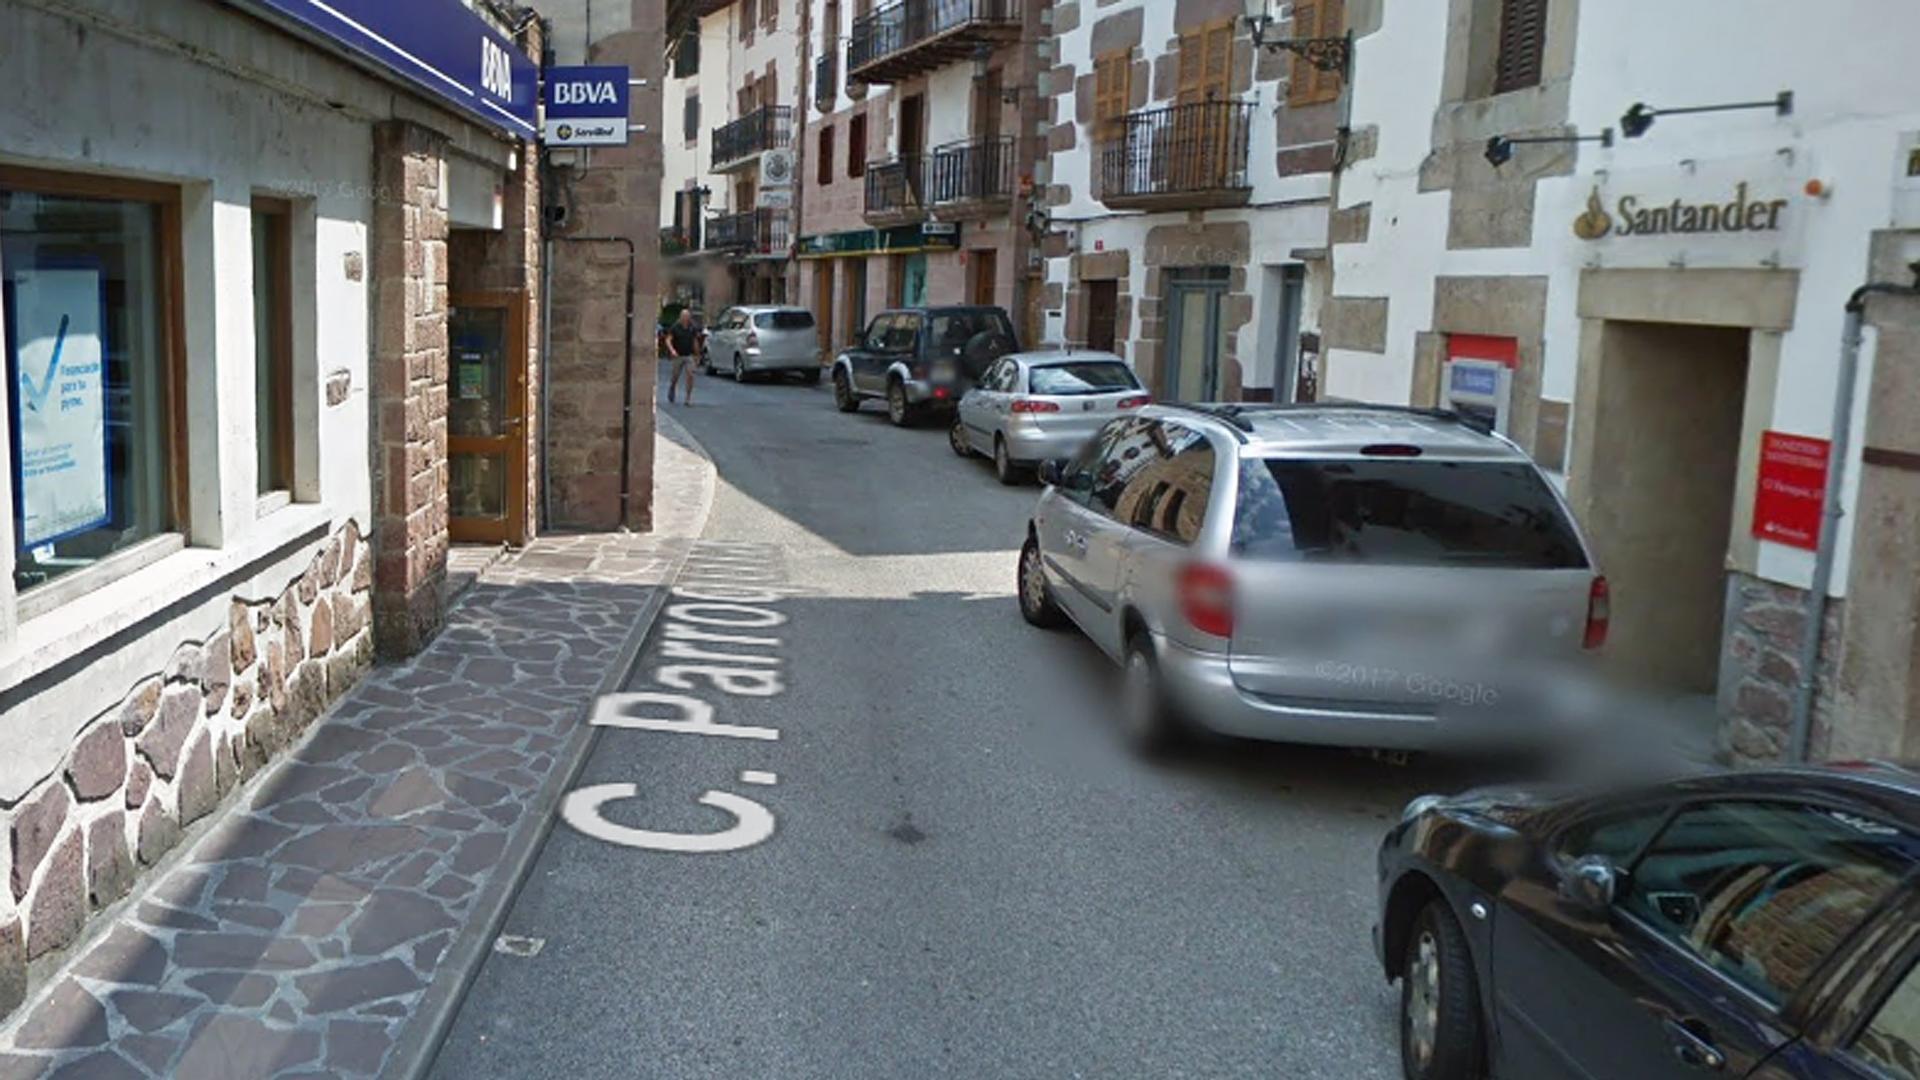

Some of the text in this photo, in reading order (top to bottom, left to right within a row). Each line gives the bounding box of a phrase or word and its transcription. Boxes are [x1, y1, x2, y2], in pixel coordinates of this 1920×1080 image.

[481, 36, 512, 103] BBVA
[554, 81, 617, 104] BBVA
[1615, 181, 1788, 236] Santander
[561, 770, 778, 852] C.
